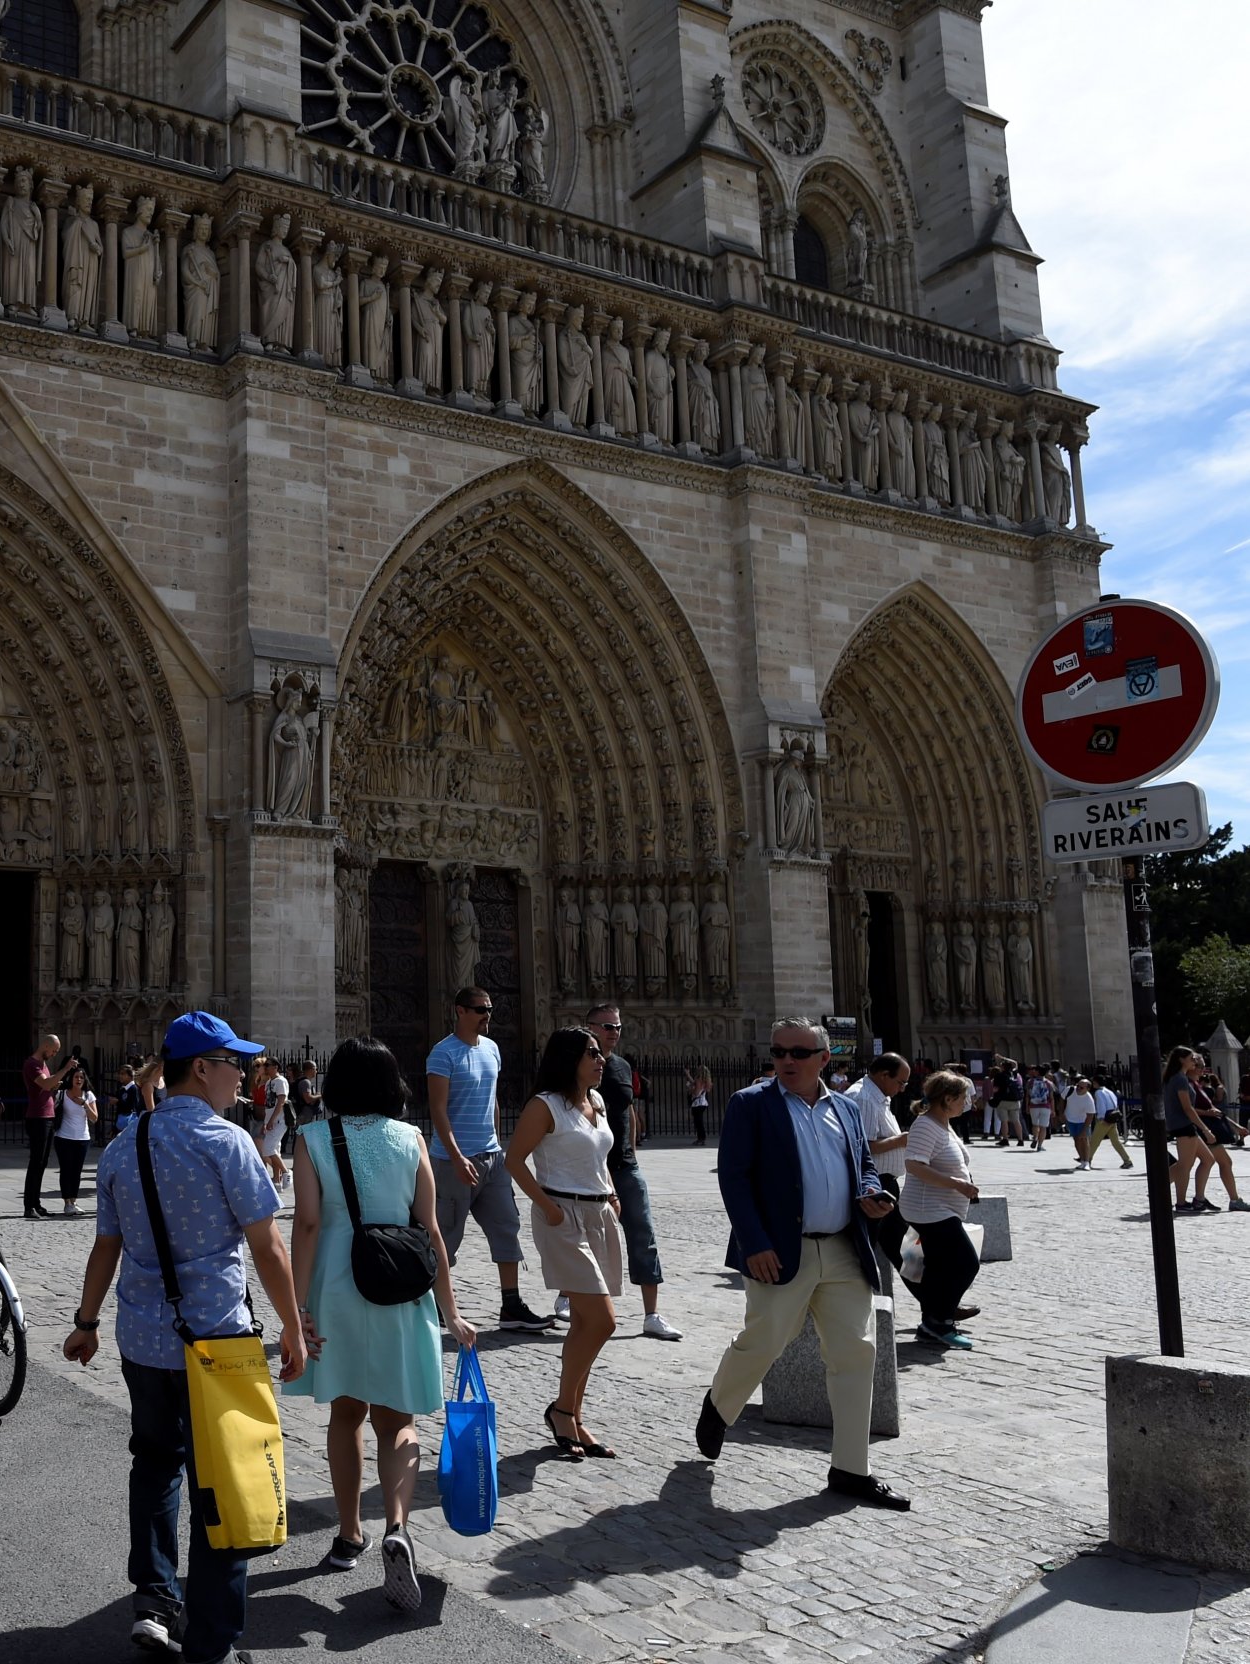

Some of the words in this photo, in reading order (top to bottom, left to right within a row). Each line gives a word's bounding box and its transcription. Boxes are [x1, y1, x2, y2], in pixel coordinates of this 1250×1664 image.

[1053, 818, 1190, 853] RIVERAINS
[265, 1452, 284, 1526] HYPERGEAR
[474, 1425, 486, 1518] www.principal.com.hk
